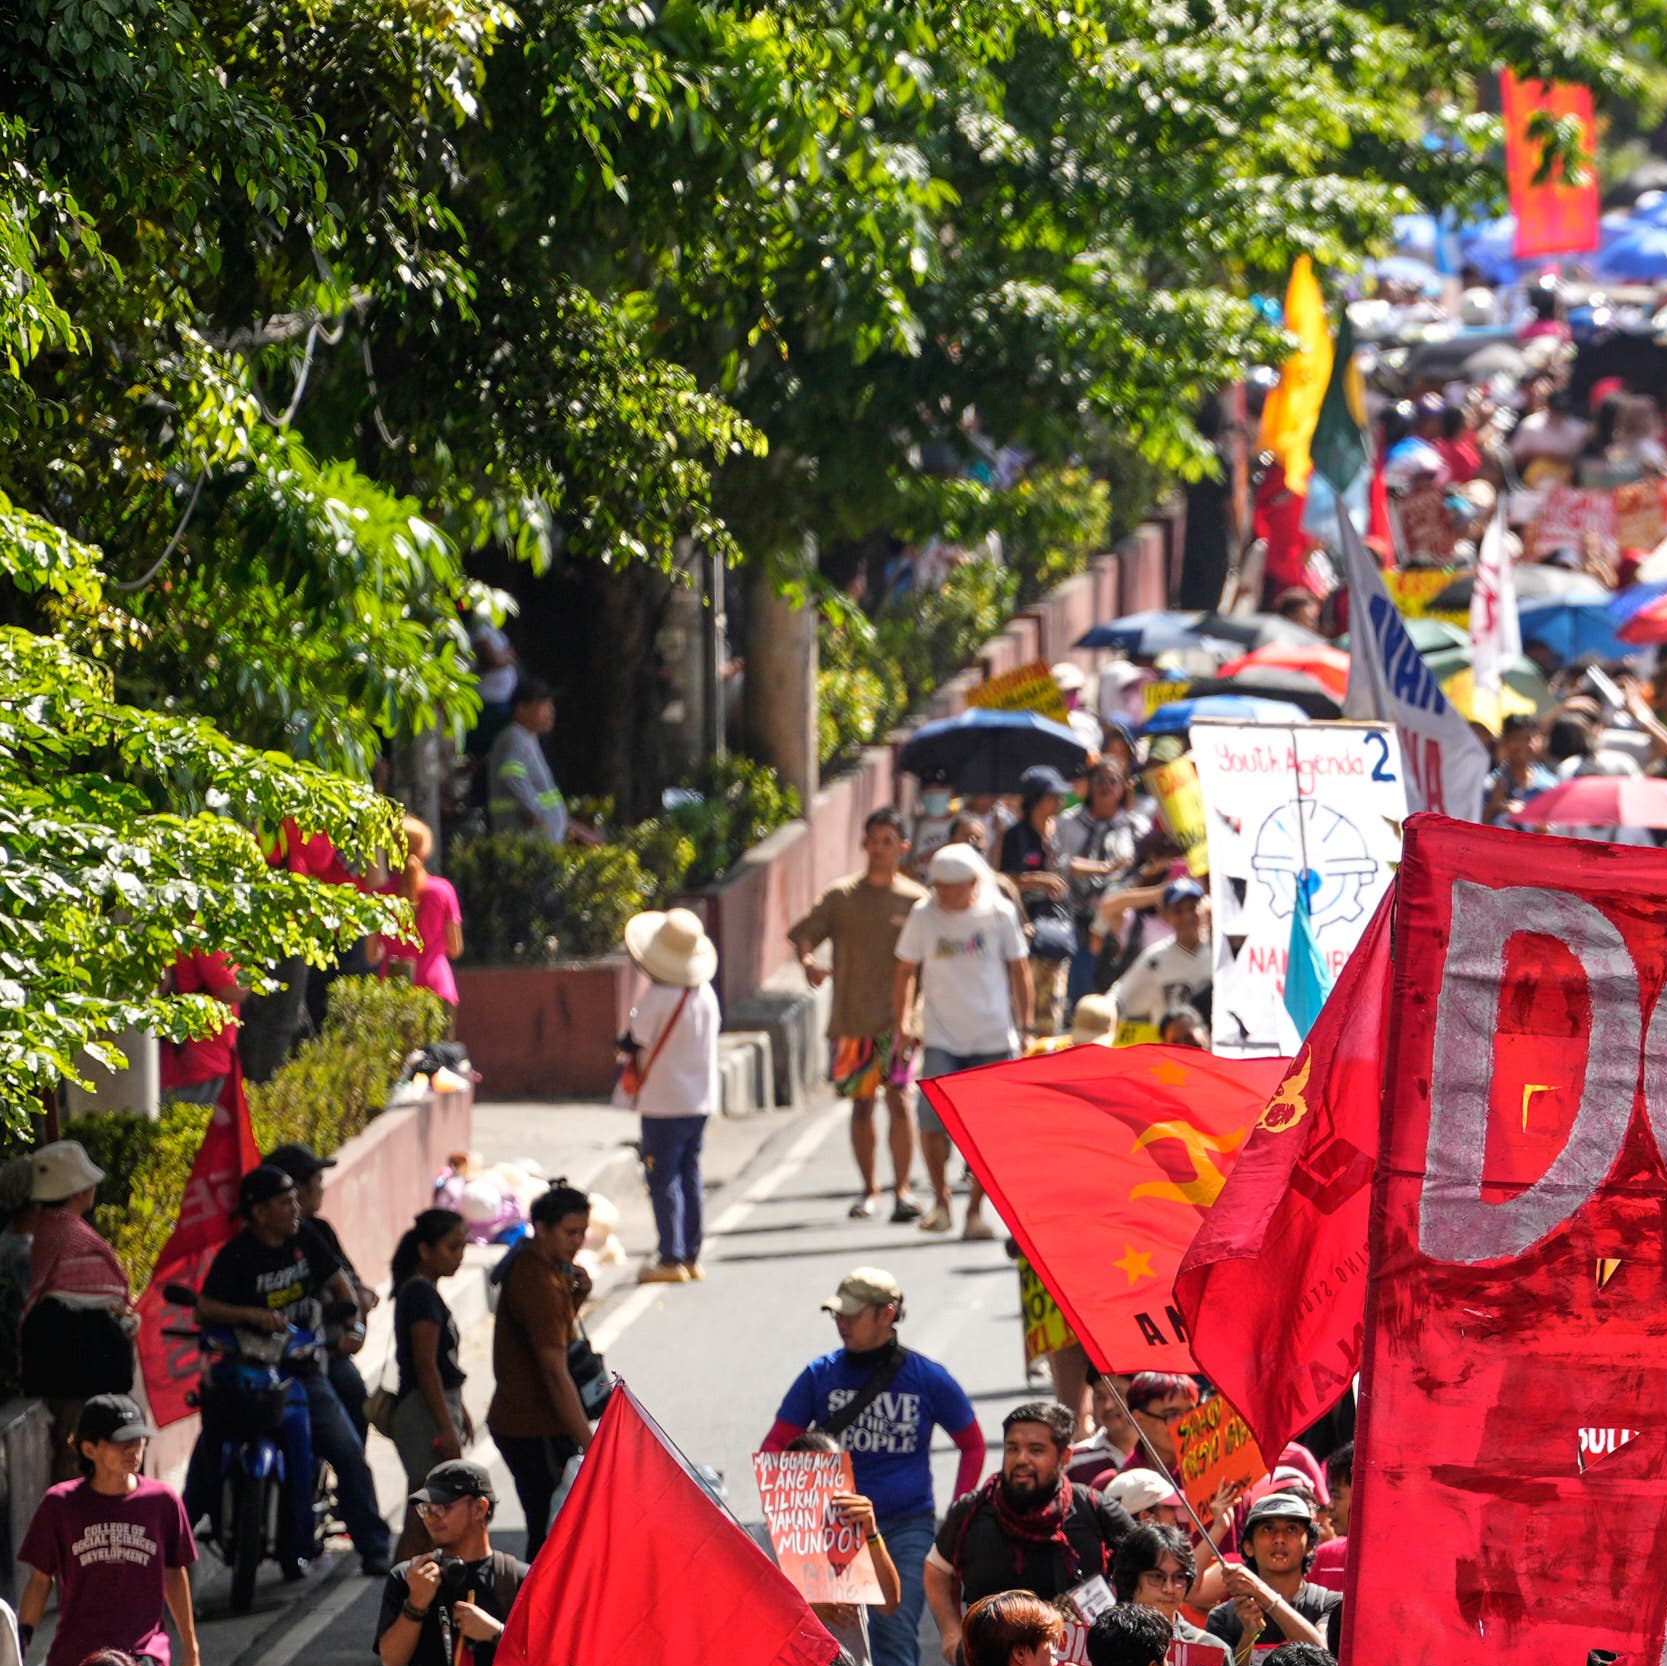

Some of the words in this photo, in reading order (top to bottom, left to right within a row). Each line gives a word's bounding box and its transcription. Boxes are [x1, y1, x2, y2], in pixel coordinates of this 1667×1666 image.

[1215, 743, 1281, 773] Youth
[1286, 746, 1365, 797] Agenda
[1363, 732, 1397, 782] 2
[760, 1471, 808, 1491] LANG
[812, 1471, 846, 1490] ANG
[768, 1508, 817, 1534] YAMAN
